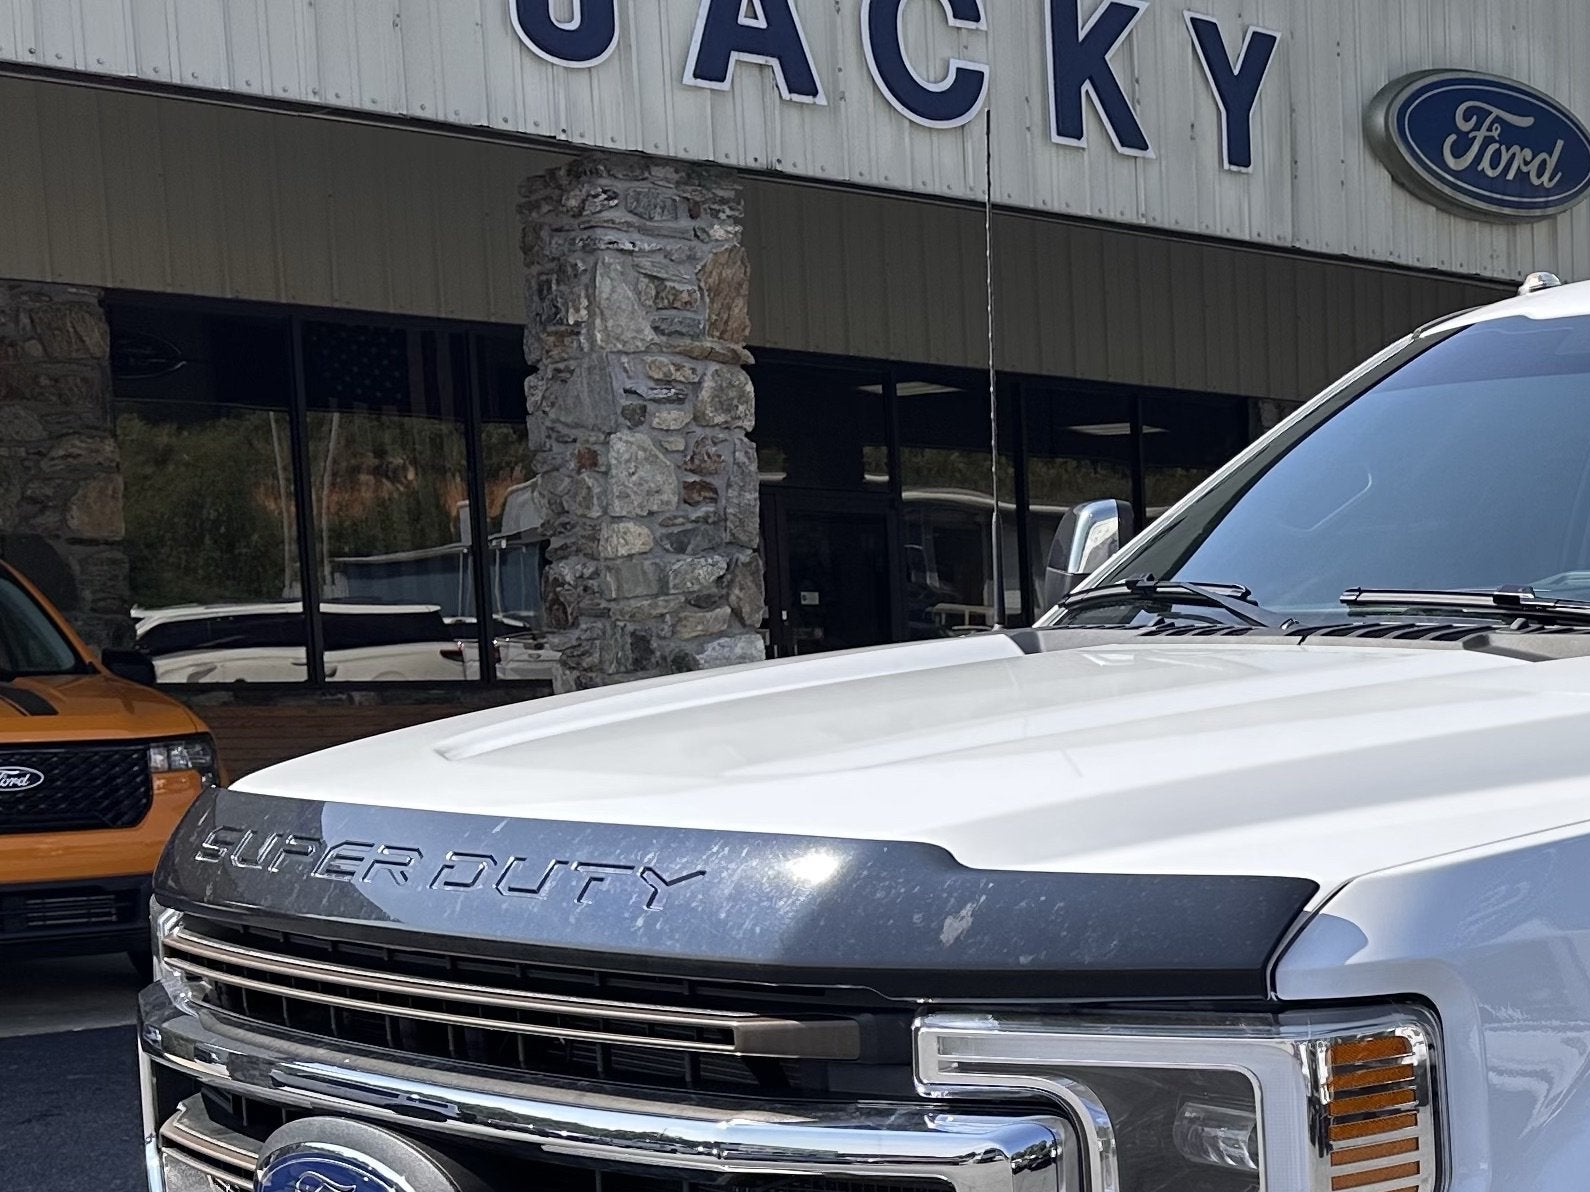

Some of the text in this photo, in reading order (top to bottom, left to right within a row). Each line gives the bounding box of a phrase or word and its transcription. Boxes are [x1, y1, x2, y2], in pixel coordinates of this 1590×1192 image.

[1442, 100, 1565, 188] Ford
[194, 825, 707, 912] SUPER DUTY
